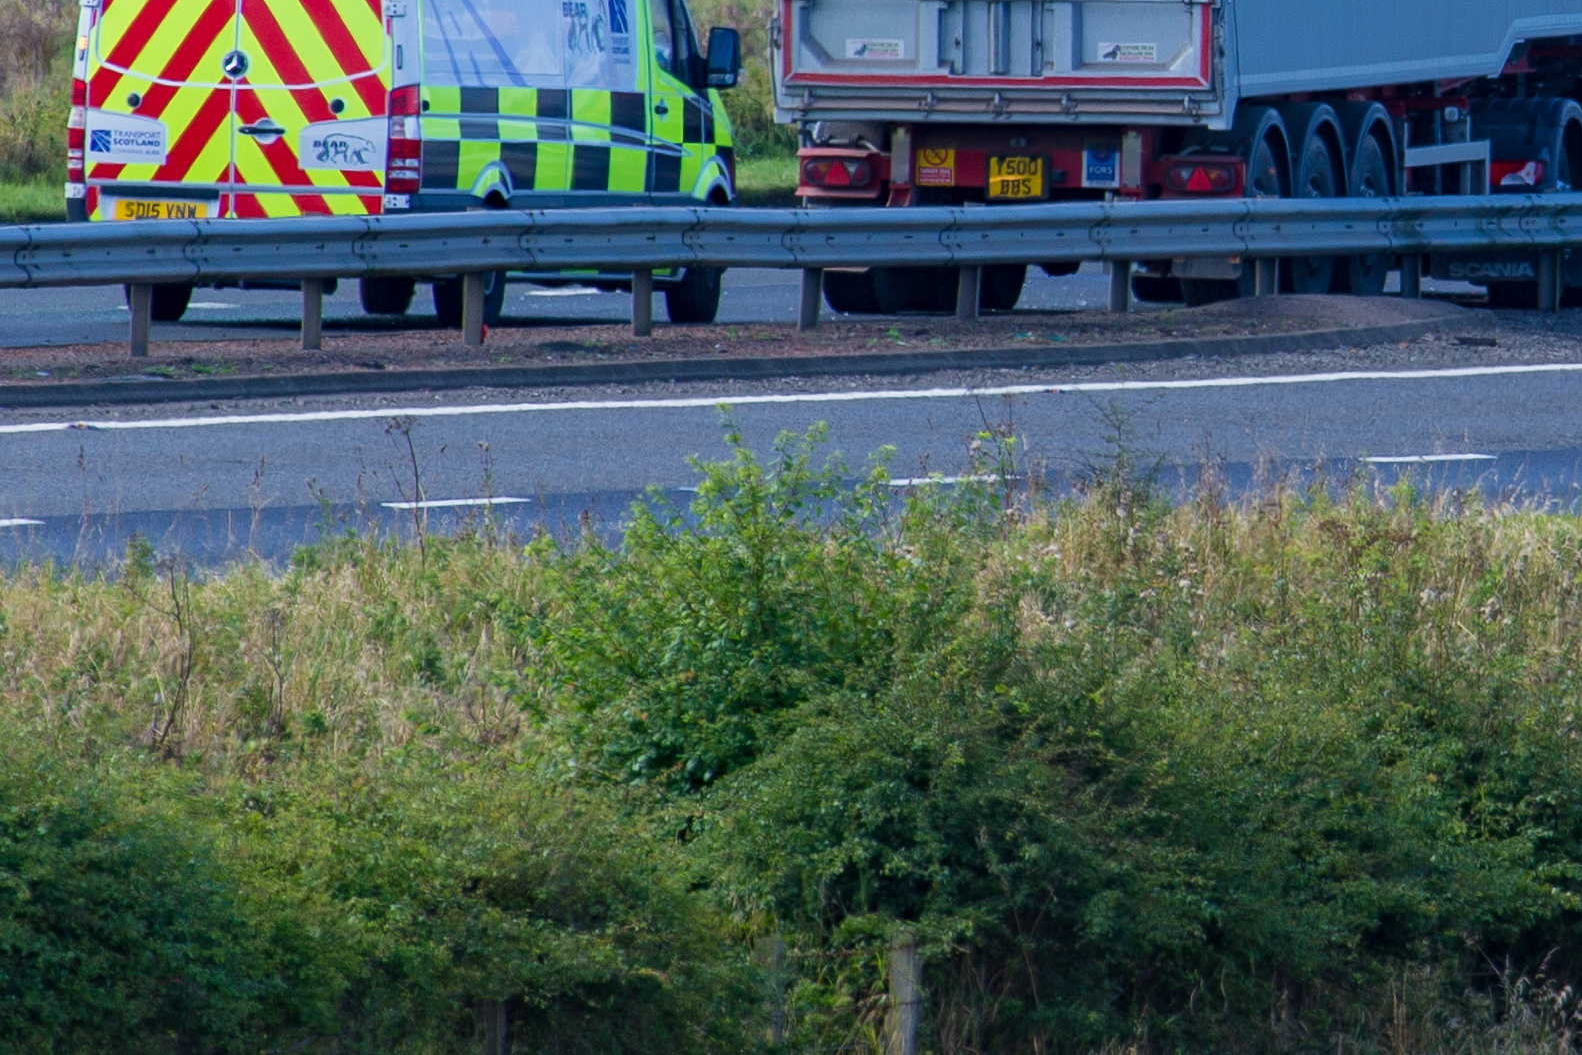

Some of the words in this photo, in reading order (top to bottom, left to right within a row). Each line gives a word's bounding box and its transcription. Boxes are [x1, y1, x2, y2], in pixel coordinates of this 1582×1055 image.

[113, 130, 161, 139] TRANSPORT
[113, 138, 161, 147] SCOTLAND
[1089, 166, 1113, 175] FORS
[125, 201, 161, 219] SD15
[166, 203, 197, 219] VNW
[1448, 262, 1535, 277] SCANIA
